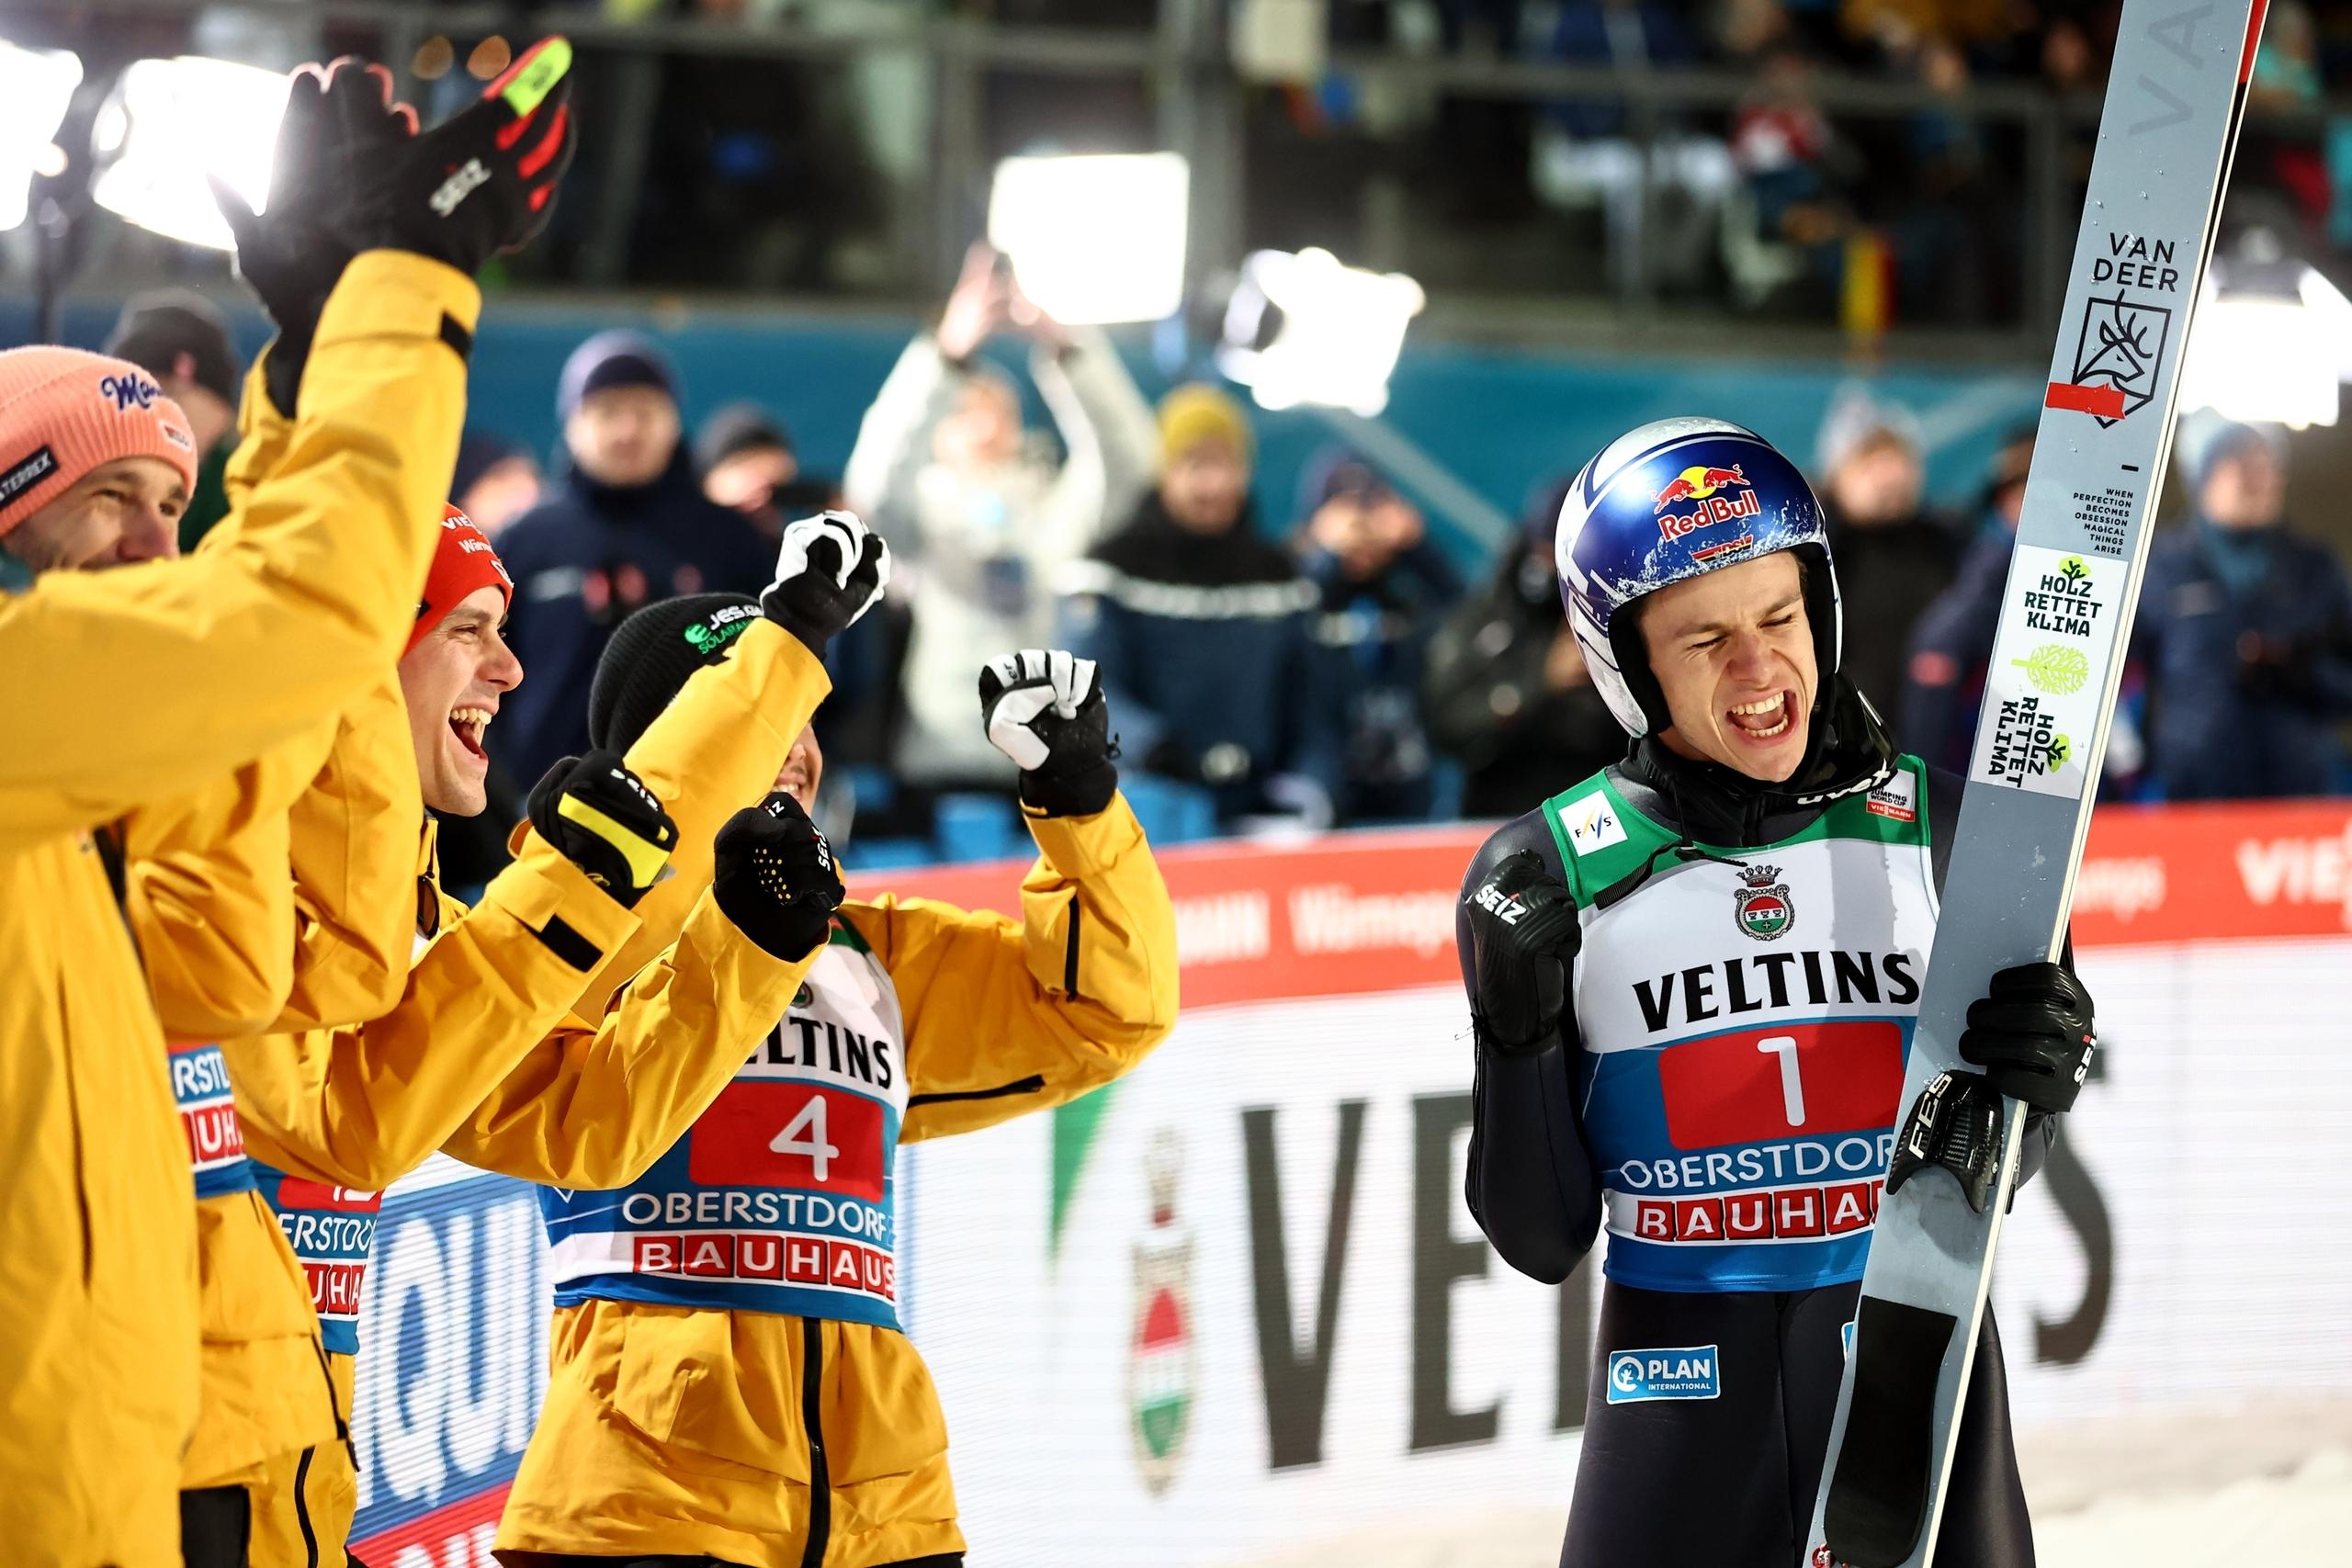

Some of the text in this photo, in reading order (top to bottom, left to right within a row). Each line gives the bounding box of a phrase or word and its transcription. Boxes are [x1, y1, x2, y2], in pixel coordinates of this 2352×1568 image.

[2109, 231, 2175, 264] VAN
[2093, 258, 2178, 292] DEER
[2073, 492, 2132, 508] PERFECTION
[2106, 488, 2133, 499] WHEN
[1657, 489, 1761, 543] Red Bull
[2075, 512, 2128, 526] OBSESSION
[2086, 504, 2130, 517] BECOMES
[2084, 523, 2125, 536] MAGICAL
[2089, 534, 2123, 546] THINGS
[2094, 545, 2122, 555] ARISE
[2040, 574, 2094, 598] HOLZ
[2024, 591, 2102, 618] RETTET
[2027, 611, 2090, 637] KLIMA
[1988, 700, 2019, 776] KLIMA
[2006, 696, 2039, 788] RETTET
[2027, 714, 2054, 776] HOLZ
[1797, 758, 1891, 805] uvex
[1871, 788, 1907, 802] JUMPING
[1871, 795, 1893, 804] WORLD
[1574, 816, 1612, 838] FIS
[1476, 884, 1526, 926] SEIZ
[1632, 951, 1920, 1033] VELTINS
[745, 1016, 891, 1090] LTINS
[1757, 1036, 1805, 1127] 1
[769, 1094, 840, 1182] 4
[623, 1191, 886, 1240] OBERSTDORF
[643, 1241, 896, 1292] BAUHAUS
[1648, 1359, 1711, 1380] PLAN
[1648, 1382, 1712, 1391] INTERNATIONAL
